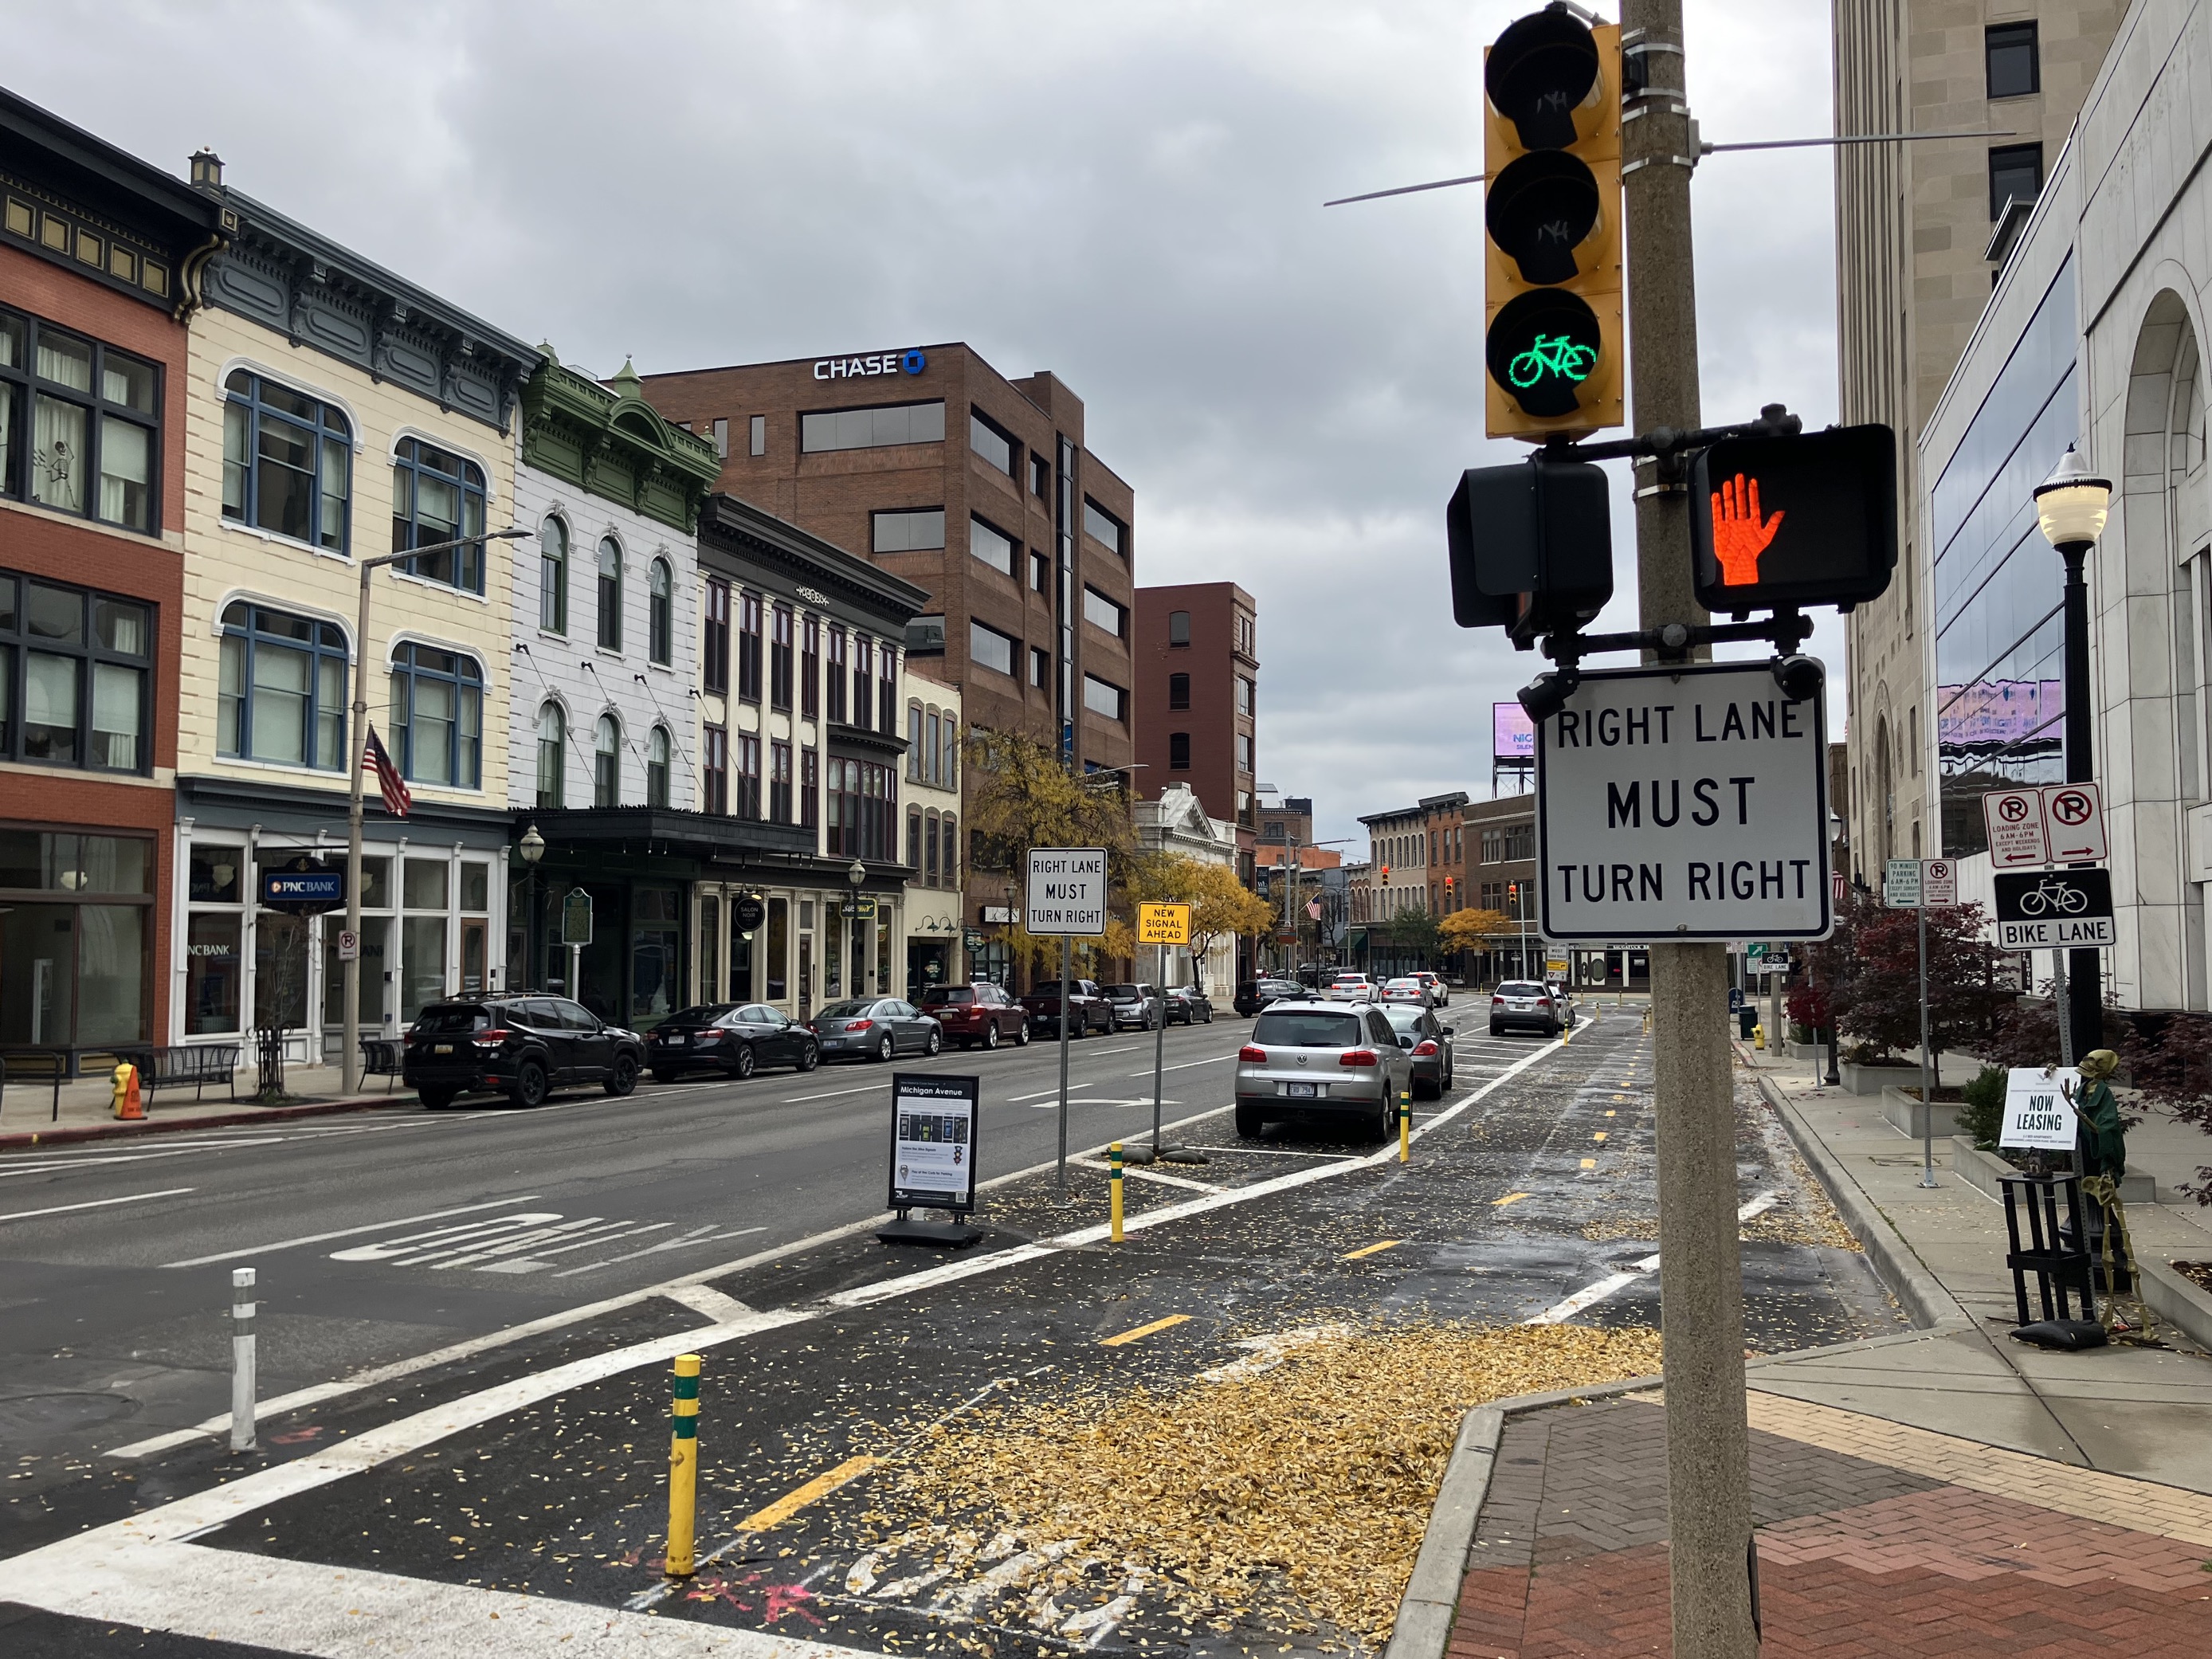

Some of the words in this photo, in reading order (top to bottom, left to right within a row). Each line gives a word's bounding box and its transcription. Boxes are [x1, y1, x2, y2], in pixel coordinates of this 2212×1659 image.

[814, 355, 898, 380] CHASE
[1558, 706, 1674, 748] RIGHT
[1695, 700, 1803, 742] LANE
[1607, 777, 1755, 829] MUST
[1992, 823, 2020, 833] LOADING
[1033, 861, 1066, 873] RIGHT
[1072, 861, 1100, 873] LANE
[283, 881, 305, 892] PNC
[307, 881, 335, 892] BANK
[1557, 863, 1663, 903] TURN
[1688, 860, 1810, 901] RIGHT
[1045, 884, 1087, 900] MUST
[1032, 910, 1061, 923] TURN
[1066, 910, 1100, 923] RIGHT
[1146, 919, 1182, 928] SIGNAL
[1147, 930, 1181, 939] AHEAD
[2006, 924, 2049, 943] BIKE
[2058, 921, 2108, 942] LANE
[203, 945, 229, 956] BANK
[900, 1086, 934, 1096] Michigan
[2029, 1095, 2054, 1112] NOW
[2016, 1114, 2062, 1131] LEASING
